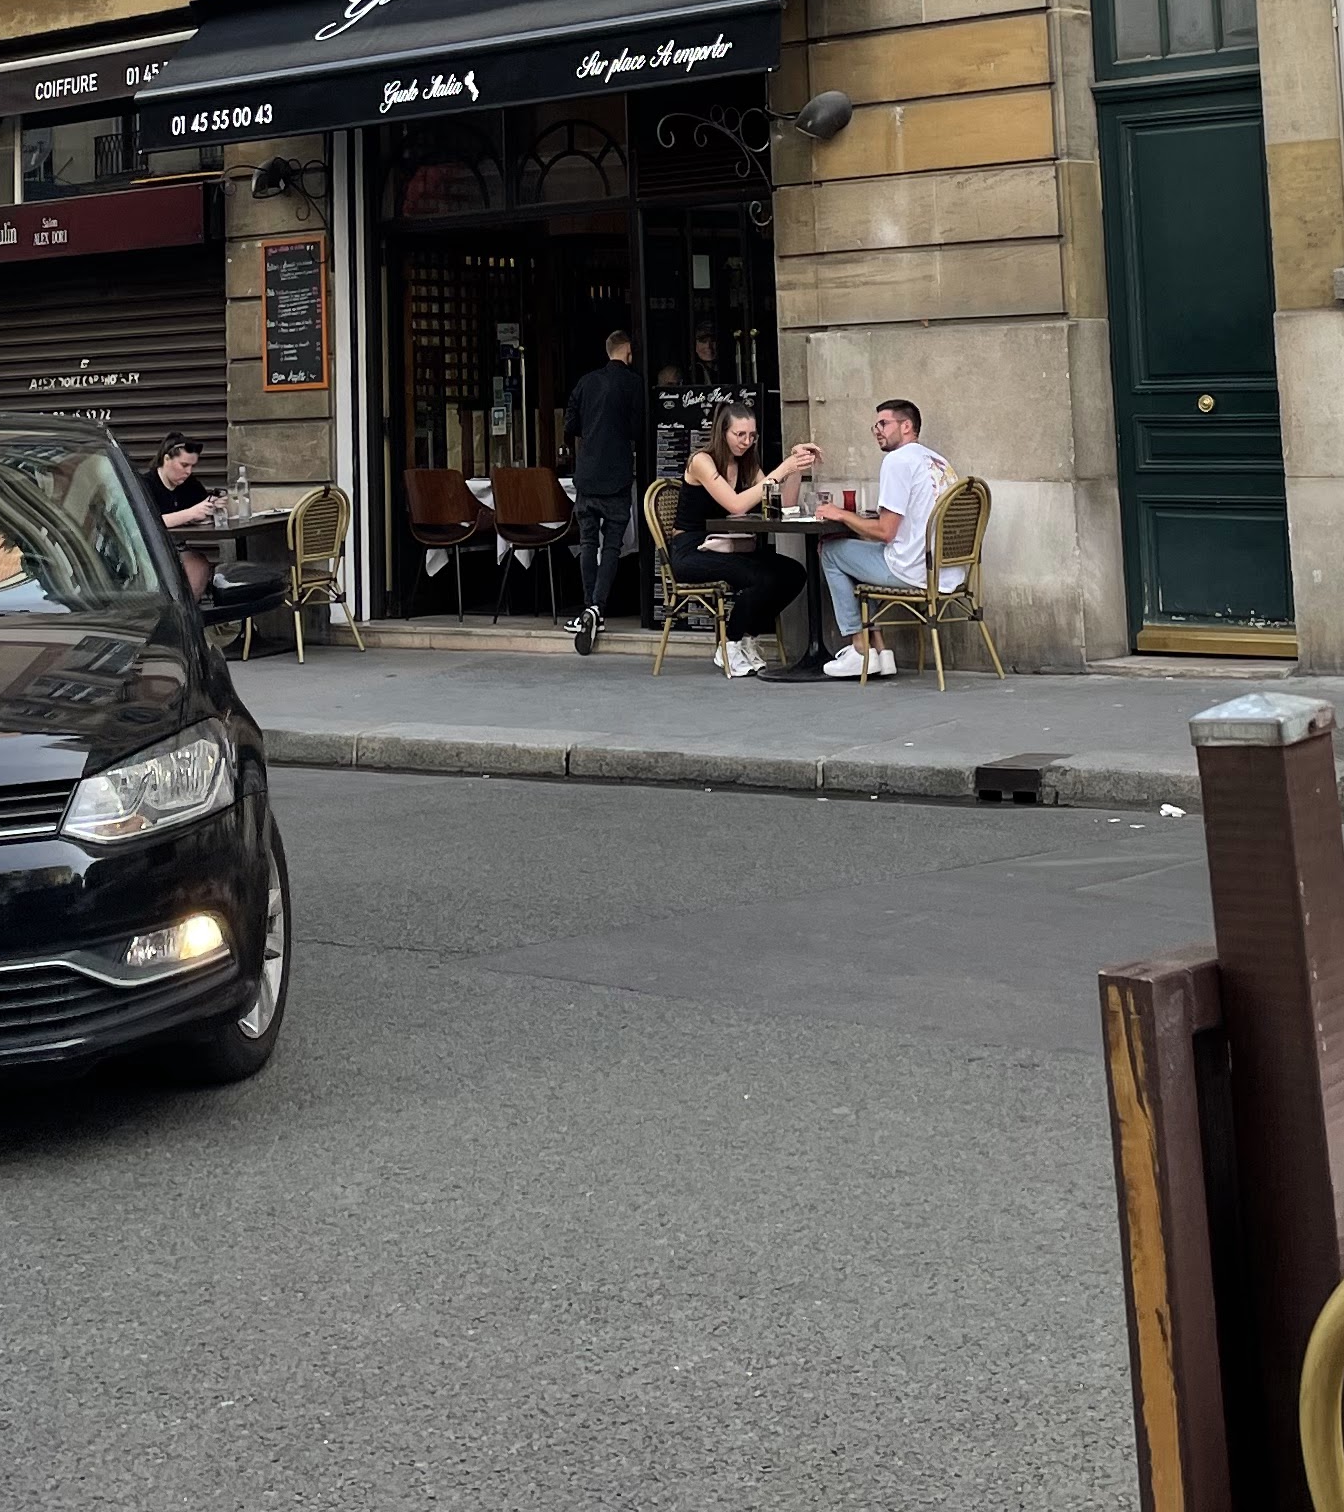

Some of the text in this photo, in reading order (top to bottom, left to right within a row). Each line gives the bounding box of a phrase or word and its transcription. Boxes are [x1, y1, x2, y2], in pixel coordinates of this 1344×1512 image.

[576, 50, 608, 80] Sur
[604, 47, 646, 84] place
[672, 33, 733, 73] emporter
[35, 73, 98, 101] COIFFURE
[126, 66, 140, 86] 01
[379, 73, 464, 114] Gusto Italia
[171, 103, 273, 136] 01 45 55 00 43
[33, 229, 68, 246] ALEX DORI
[42, 217, 58, 229] Salon
